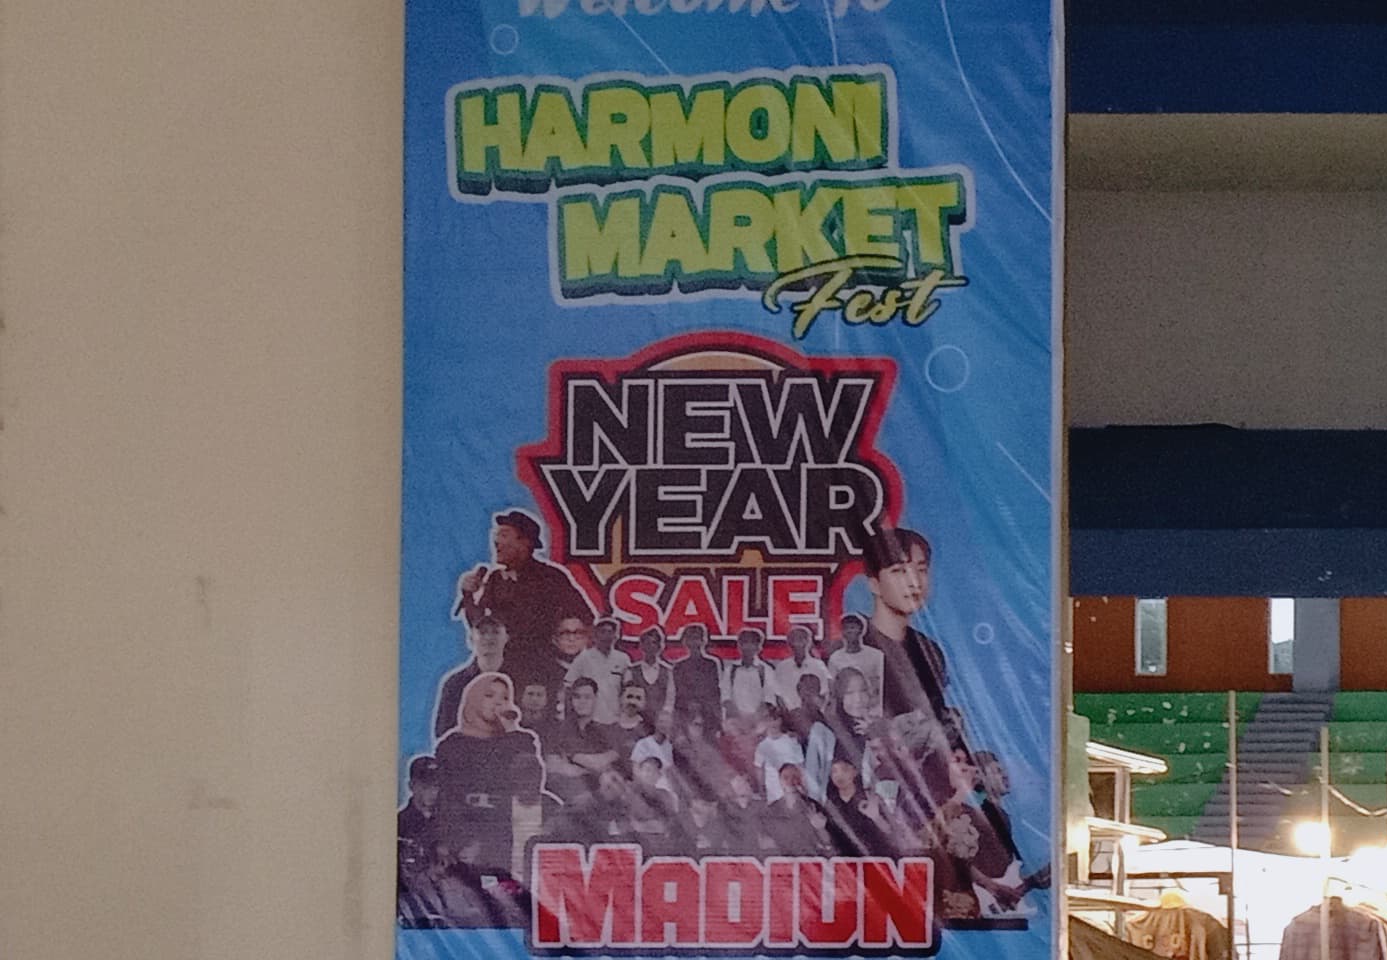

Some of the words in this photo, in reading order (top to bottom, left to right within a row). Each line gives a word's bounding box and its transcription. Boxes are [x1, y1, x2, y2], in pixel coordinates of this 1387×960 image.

[457, 75, 887, 184] HARMONI
[557, 180, 963, 290] MARKET
[763, 254, 968, 339] Fest
[567, 378, 874, 467] NEW
[543, 465, 883, 555] YEAR
[608, 574, 823, 642] SALE
[532, 843, 935, 948] MADIUN
